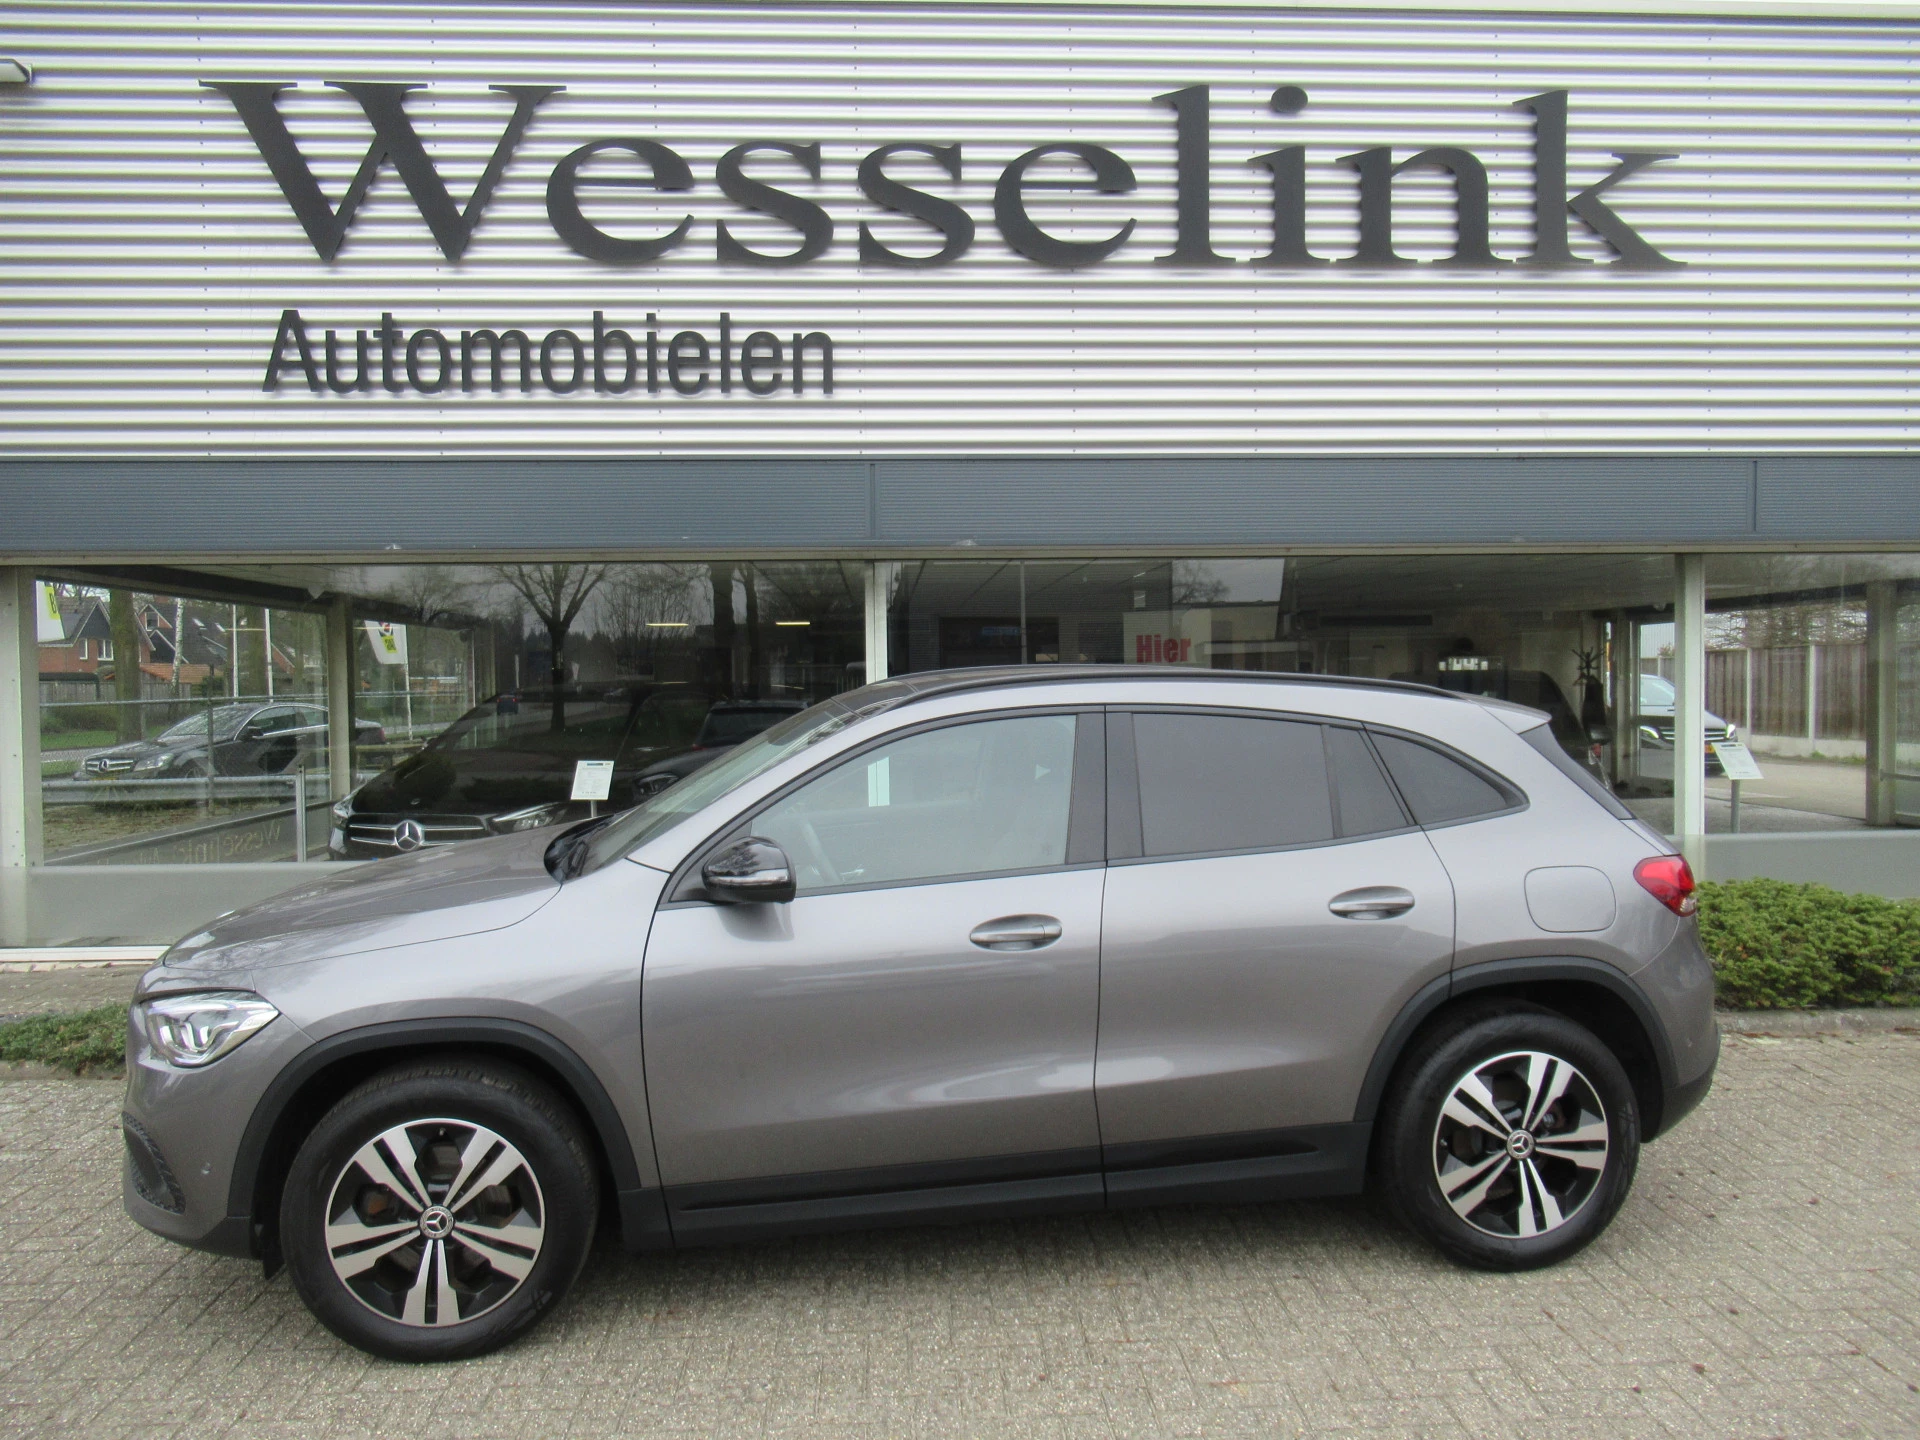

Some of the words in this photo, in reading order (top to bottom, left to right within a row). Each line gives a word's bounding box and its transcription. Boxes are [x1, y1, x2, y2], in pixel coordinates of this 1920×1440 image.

[198, 81, 1688, 267] Wesselink
[262, 309, 834, 395] Automobielen
[1136, 633, 1191, 663] Hier
